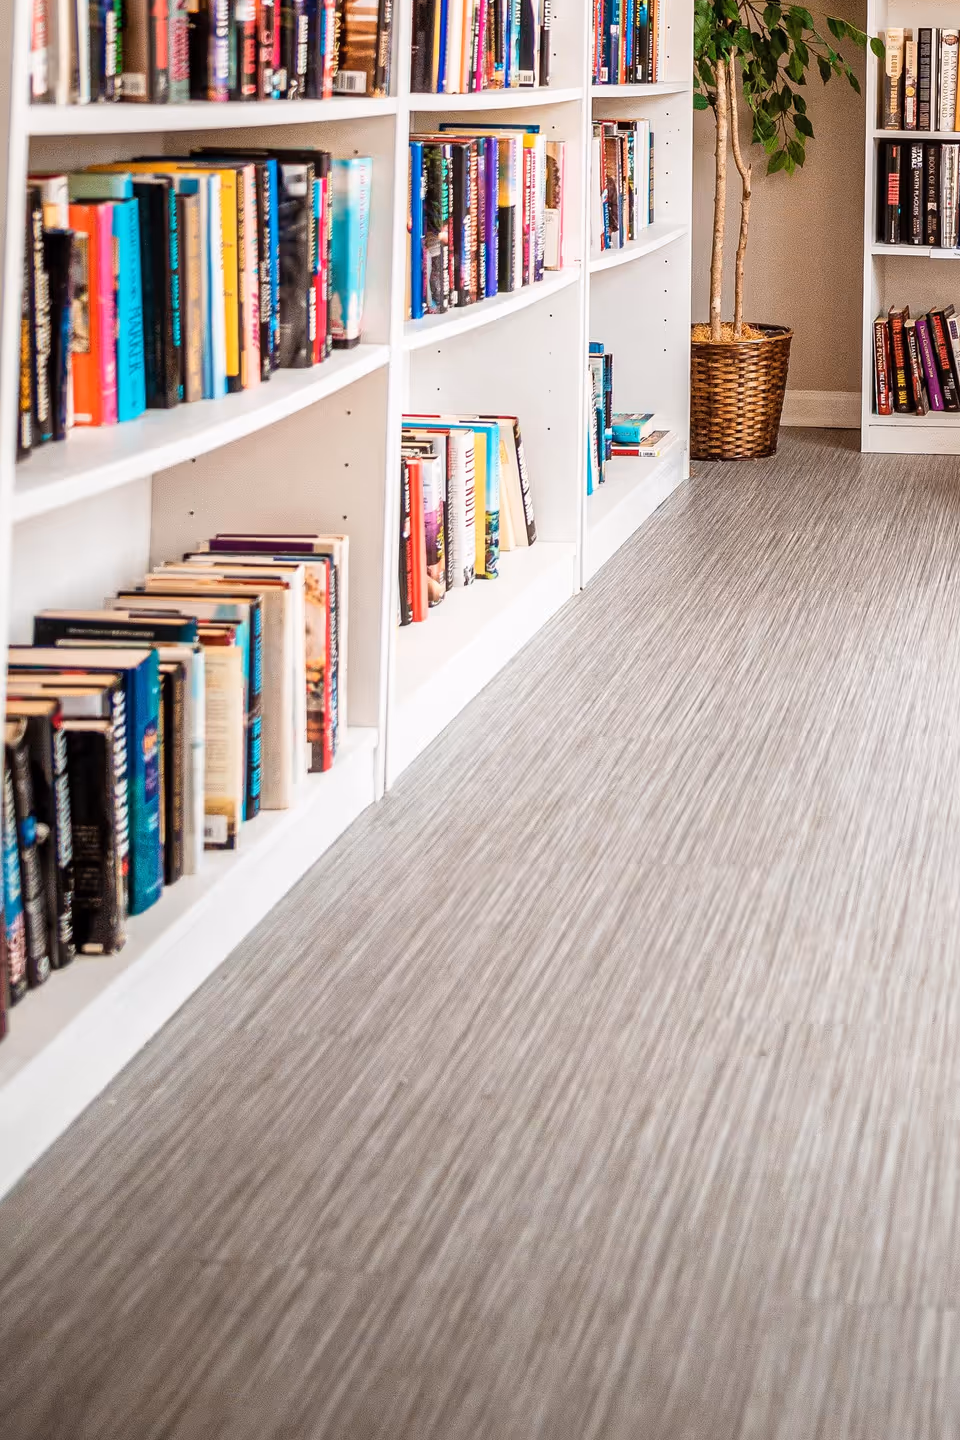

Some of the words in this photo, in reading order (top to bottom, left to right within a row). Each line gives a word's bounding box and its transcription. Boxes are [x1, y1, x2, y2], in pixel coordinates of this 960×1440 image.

[950, 74, 956, 83] OF
[929, 176, 935, 184] OF
[893, 320, 901, 333] FAYE
[128, 307, 143, 375] MARKER
[933, 316, 945, 345] CATHERINE
[939, 346, 950, 369] COULTER
[897, 370, 905, 387] BONE
[899, 391, 907, 404] BOX
